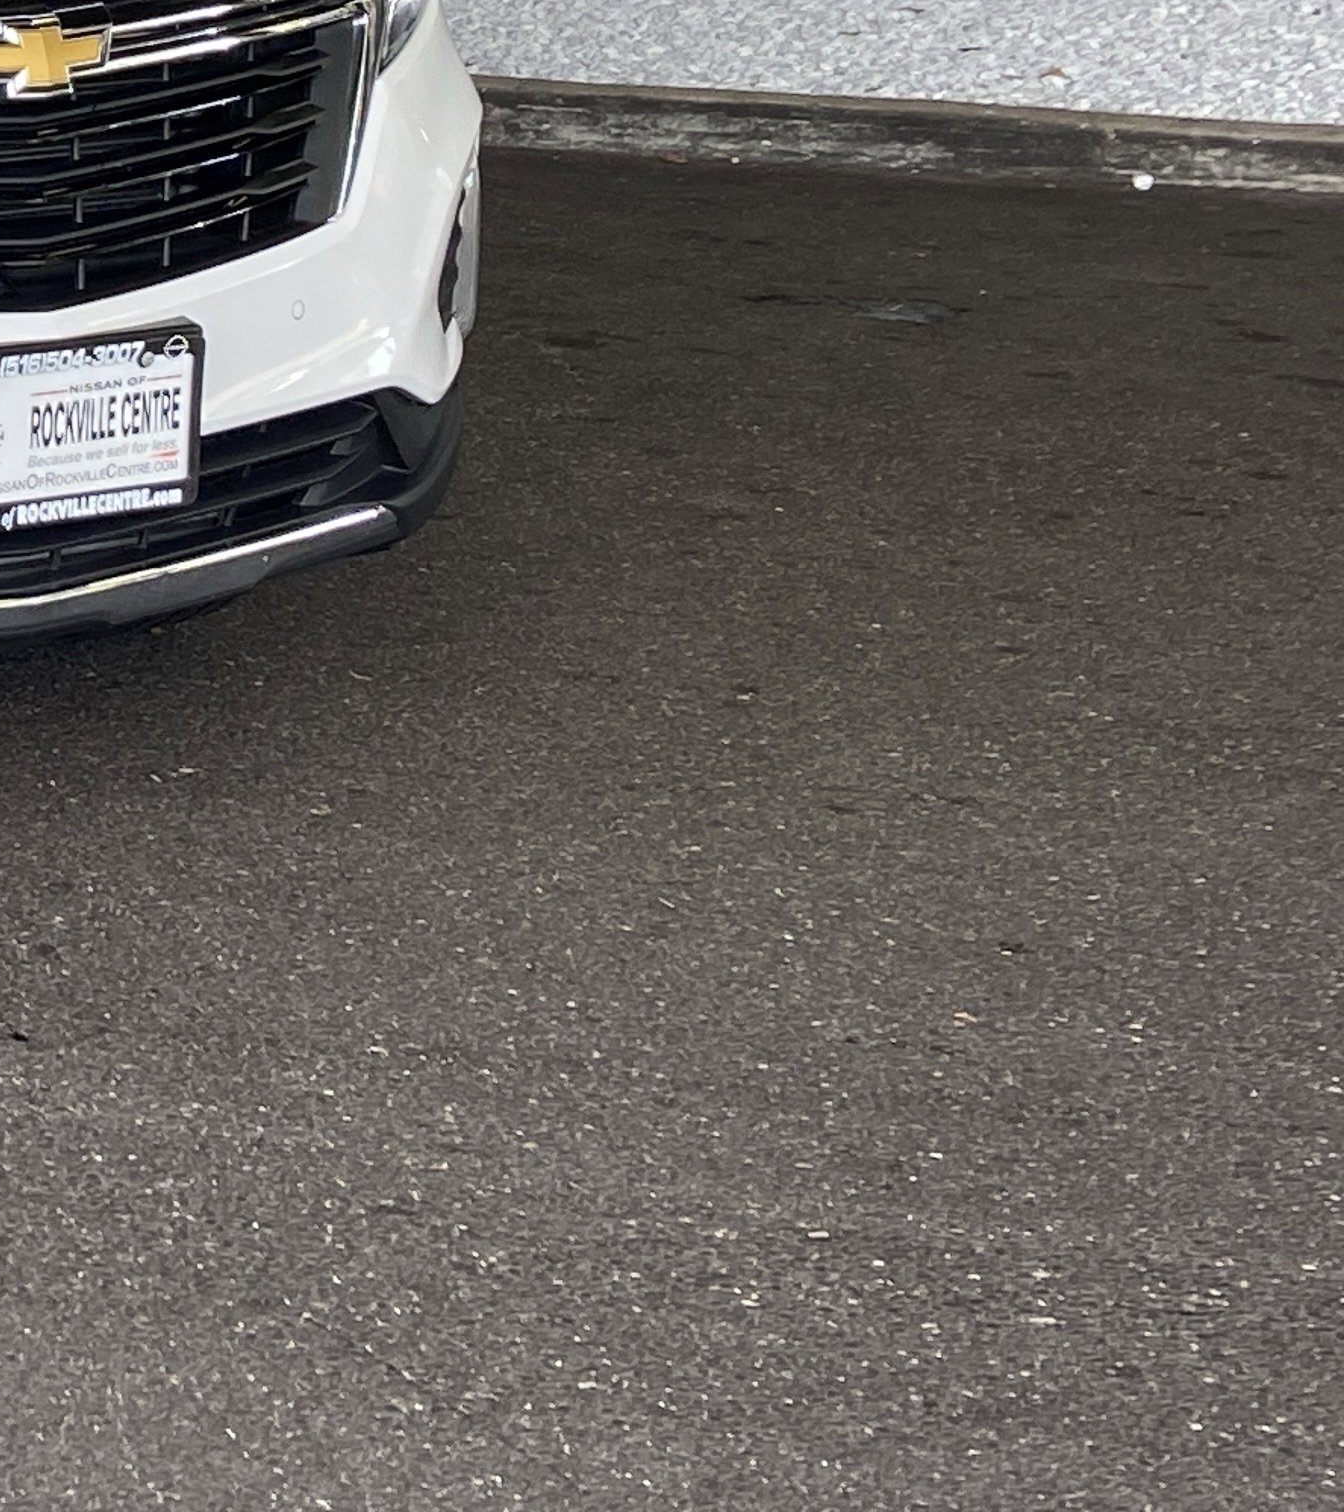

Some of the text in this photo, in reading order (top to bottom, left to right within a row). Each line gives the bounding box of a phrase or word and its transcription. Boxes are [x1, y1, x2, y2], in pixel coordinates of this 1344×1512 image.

[69, 375, 147, 393] NISSAN OF
[29, 387, 181, 449] ROCKVILLE CENTRE
[1, 505, 17, 531] of
